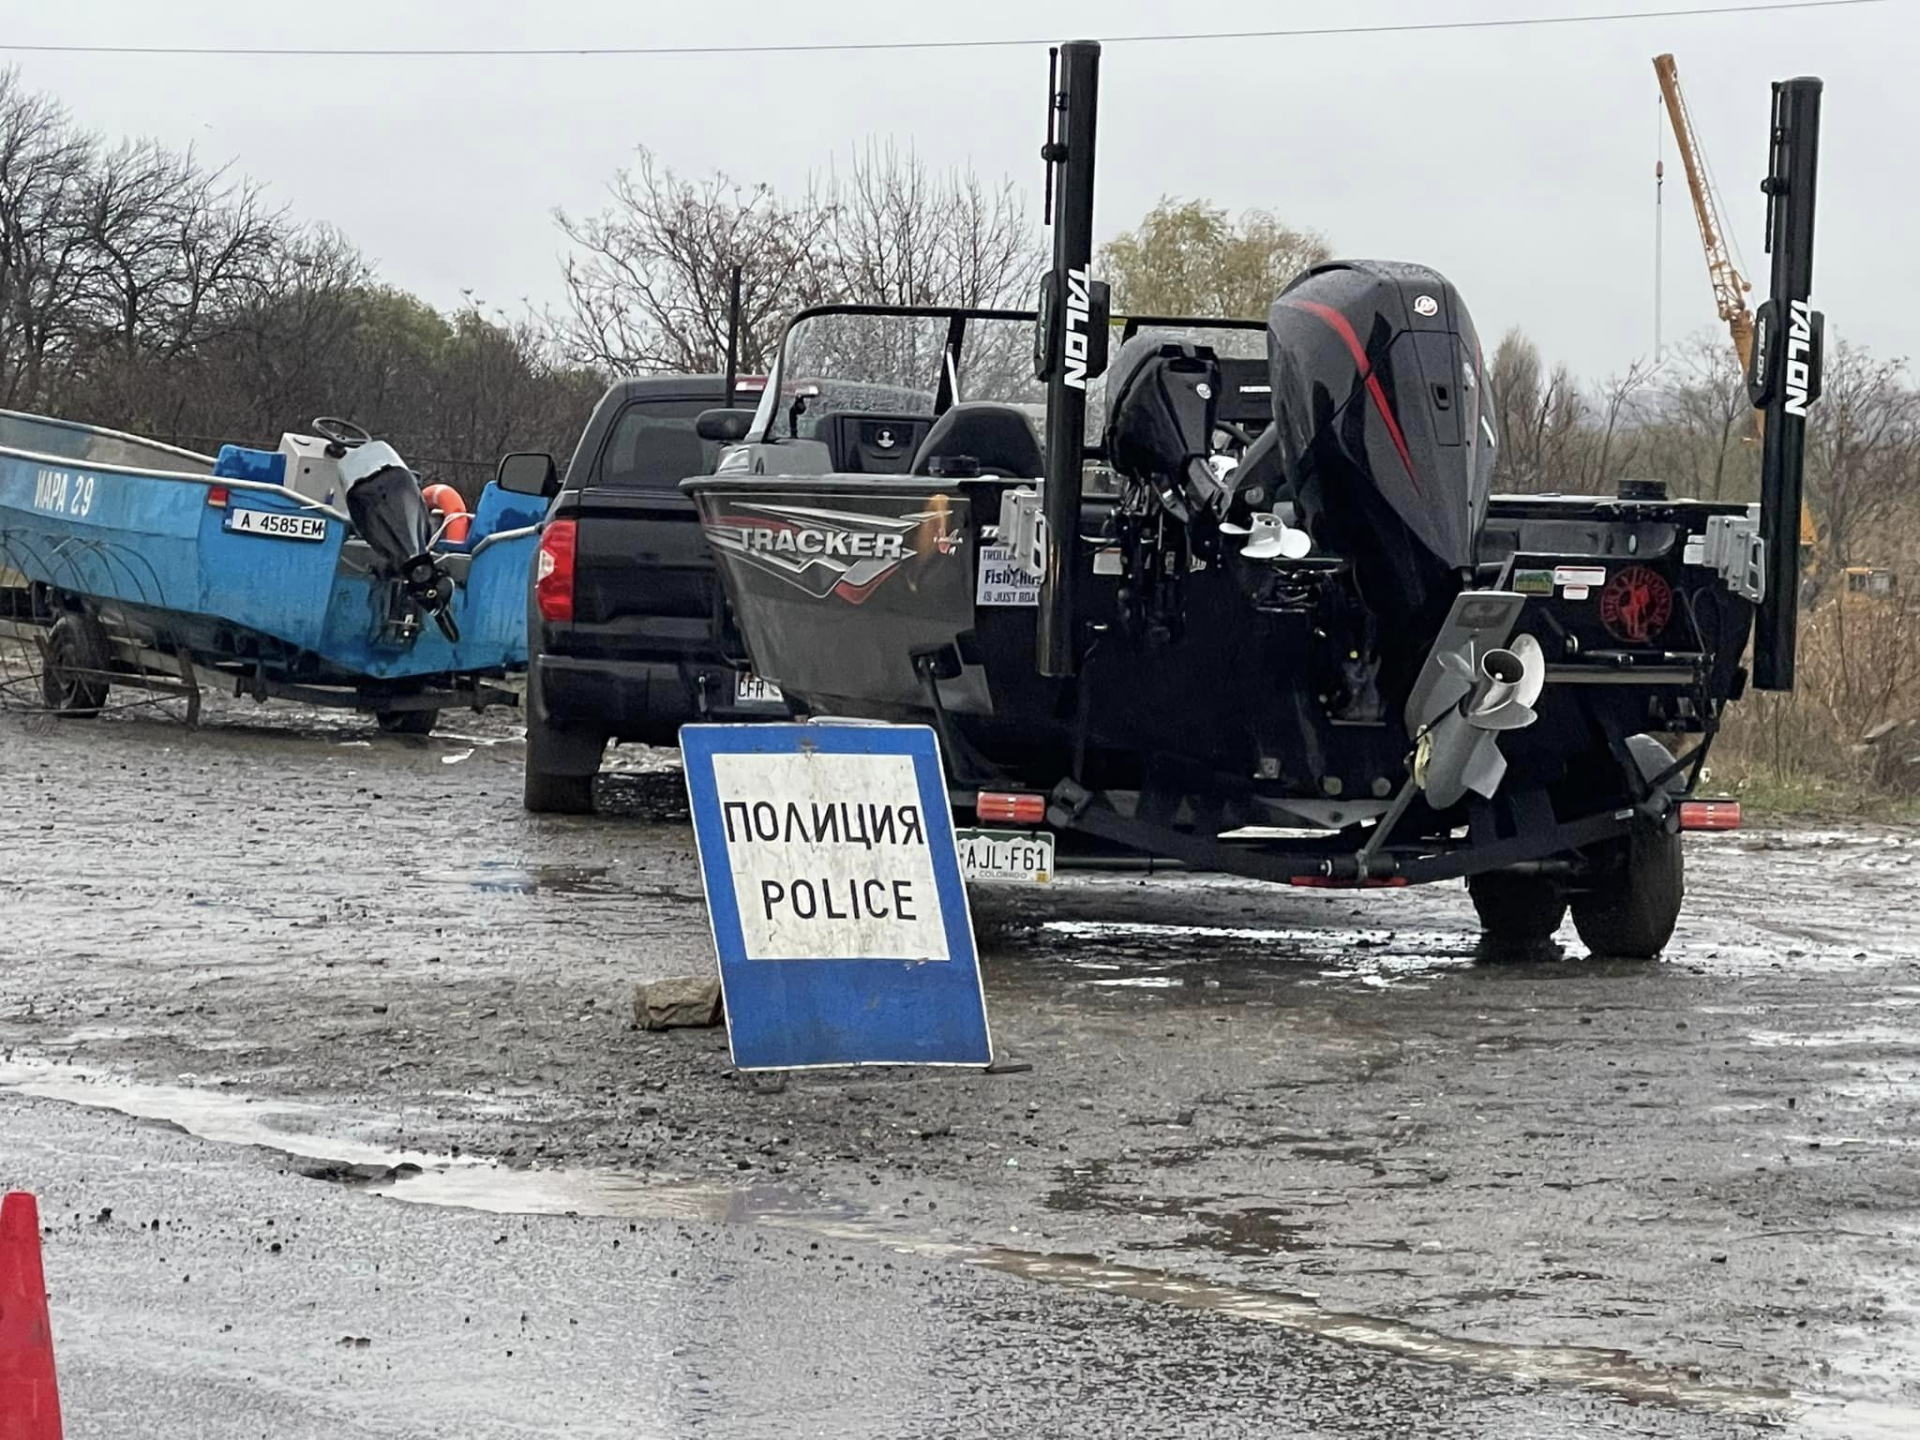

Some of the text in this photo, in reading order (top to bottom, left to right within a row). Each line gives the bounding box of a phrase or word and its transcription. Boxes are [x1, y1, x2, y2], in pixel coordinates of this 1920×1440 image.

[1064, 263, 1091, 390] TALON
[1784, 295, 1812, 418] TALON
[70, 475, 94, 517] 29
[260, 515, 299, 534] 4585
[301, 519, 324, 537] EM
[740, 527, 904, 559] TRACKER
[994, 591, 1017, 602] JUST
[1018, 591, 1036, 603] BOA
[724, 801, 924, 850] ПОЛИЦИЯ
[761, 878, 917, 921] POLICE
